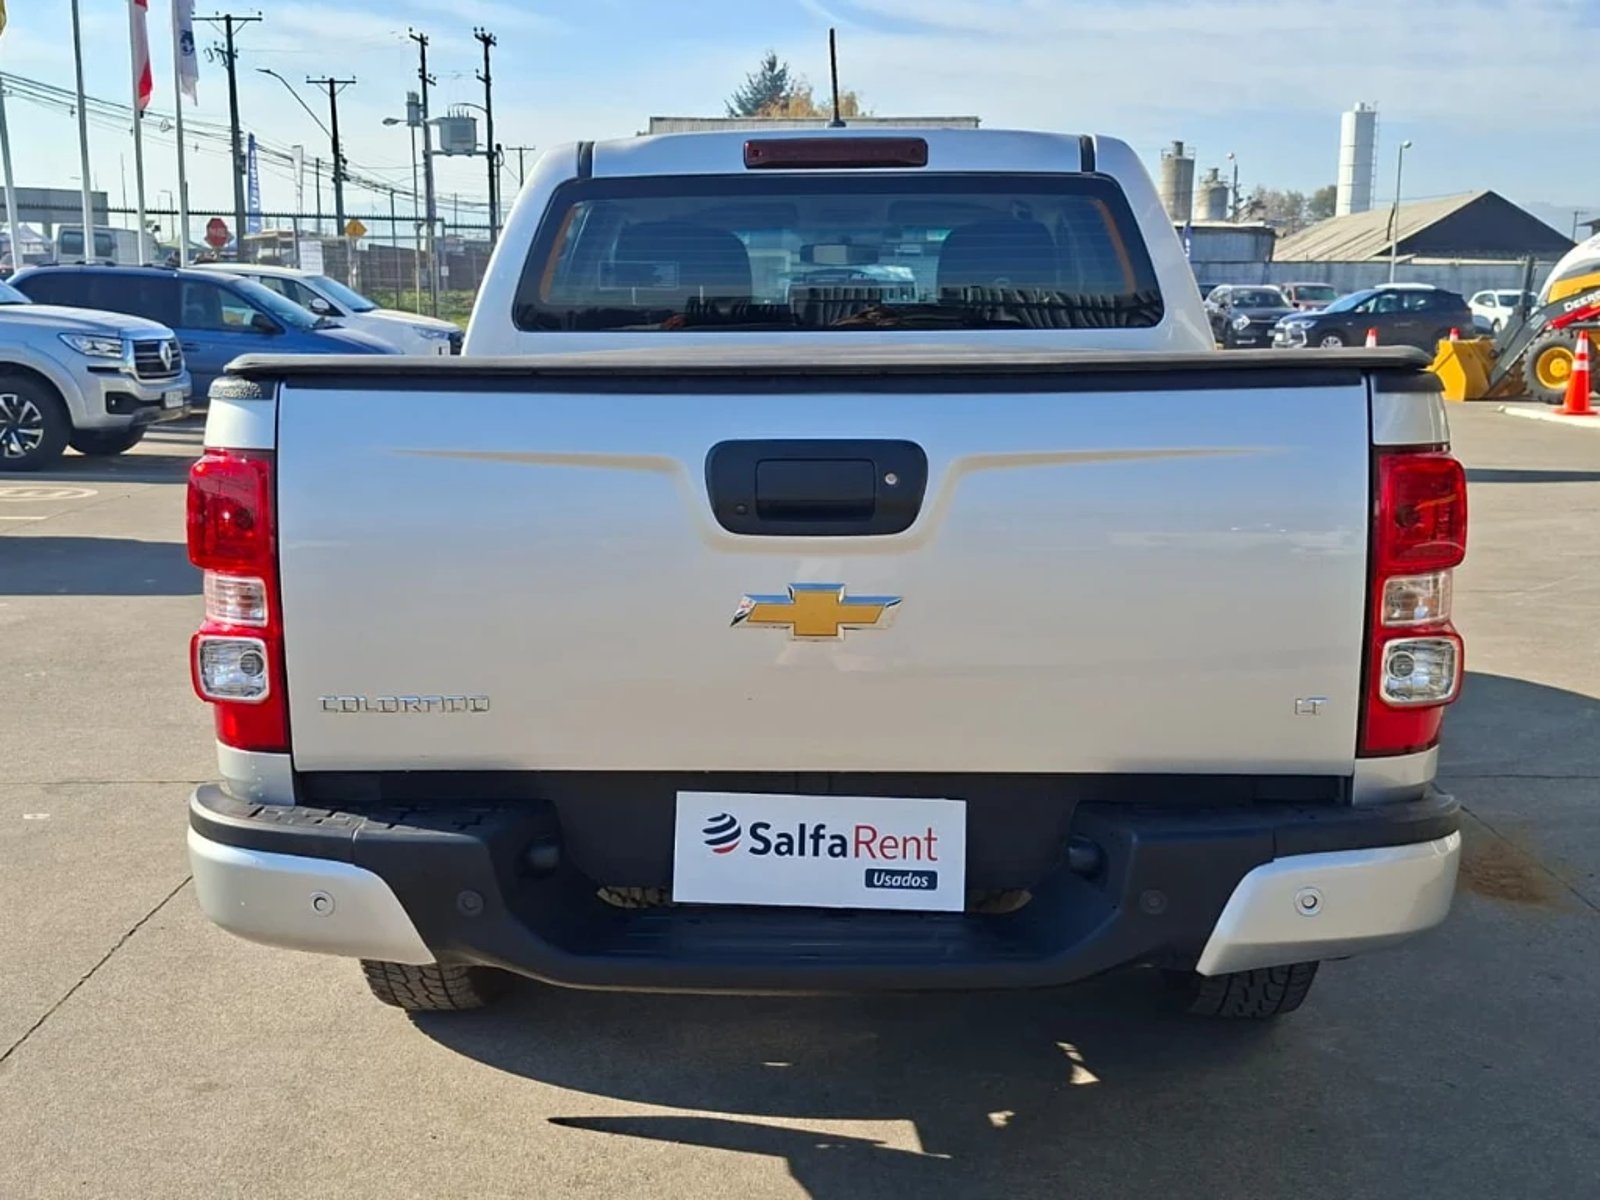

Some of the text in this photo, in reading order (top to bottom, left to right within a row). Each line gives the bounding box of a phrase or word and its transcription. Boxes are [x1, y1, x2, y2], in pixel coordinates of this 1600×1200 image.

[318, 696, 491, 713] COLORADO
[1294, 697, 1328, 716] LT
[749, 822, 939, 861] SalfaRent
[872, 871, 929, 888] Usados
